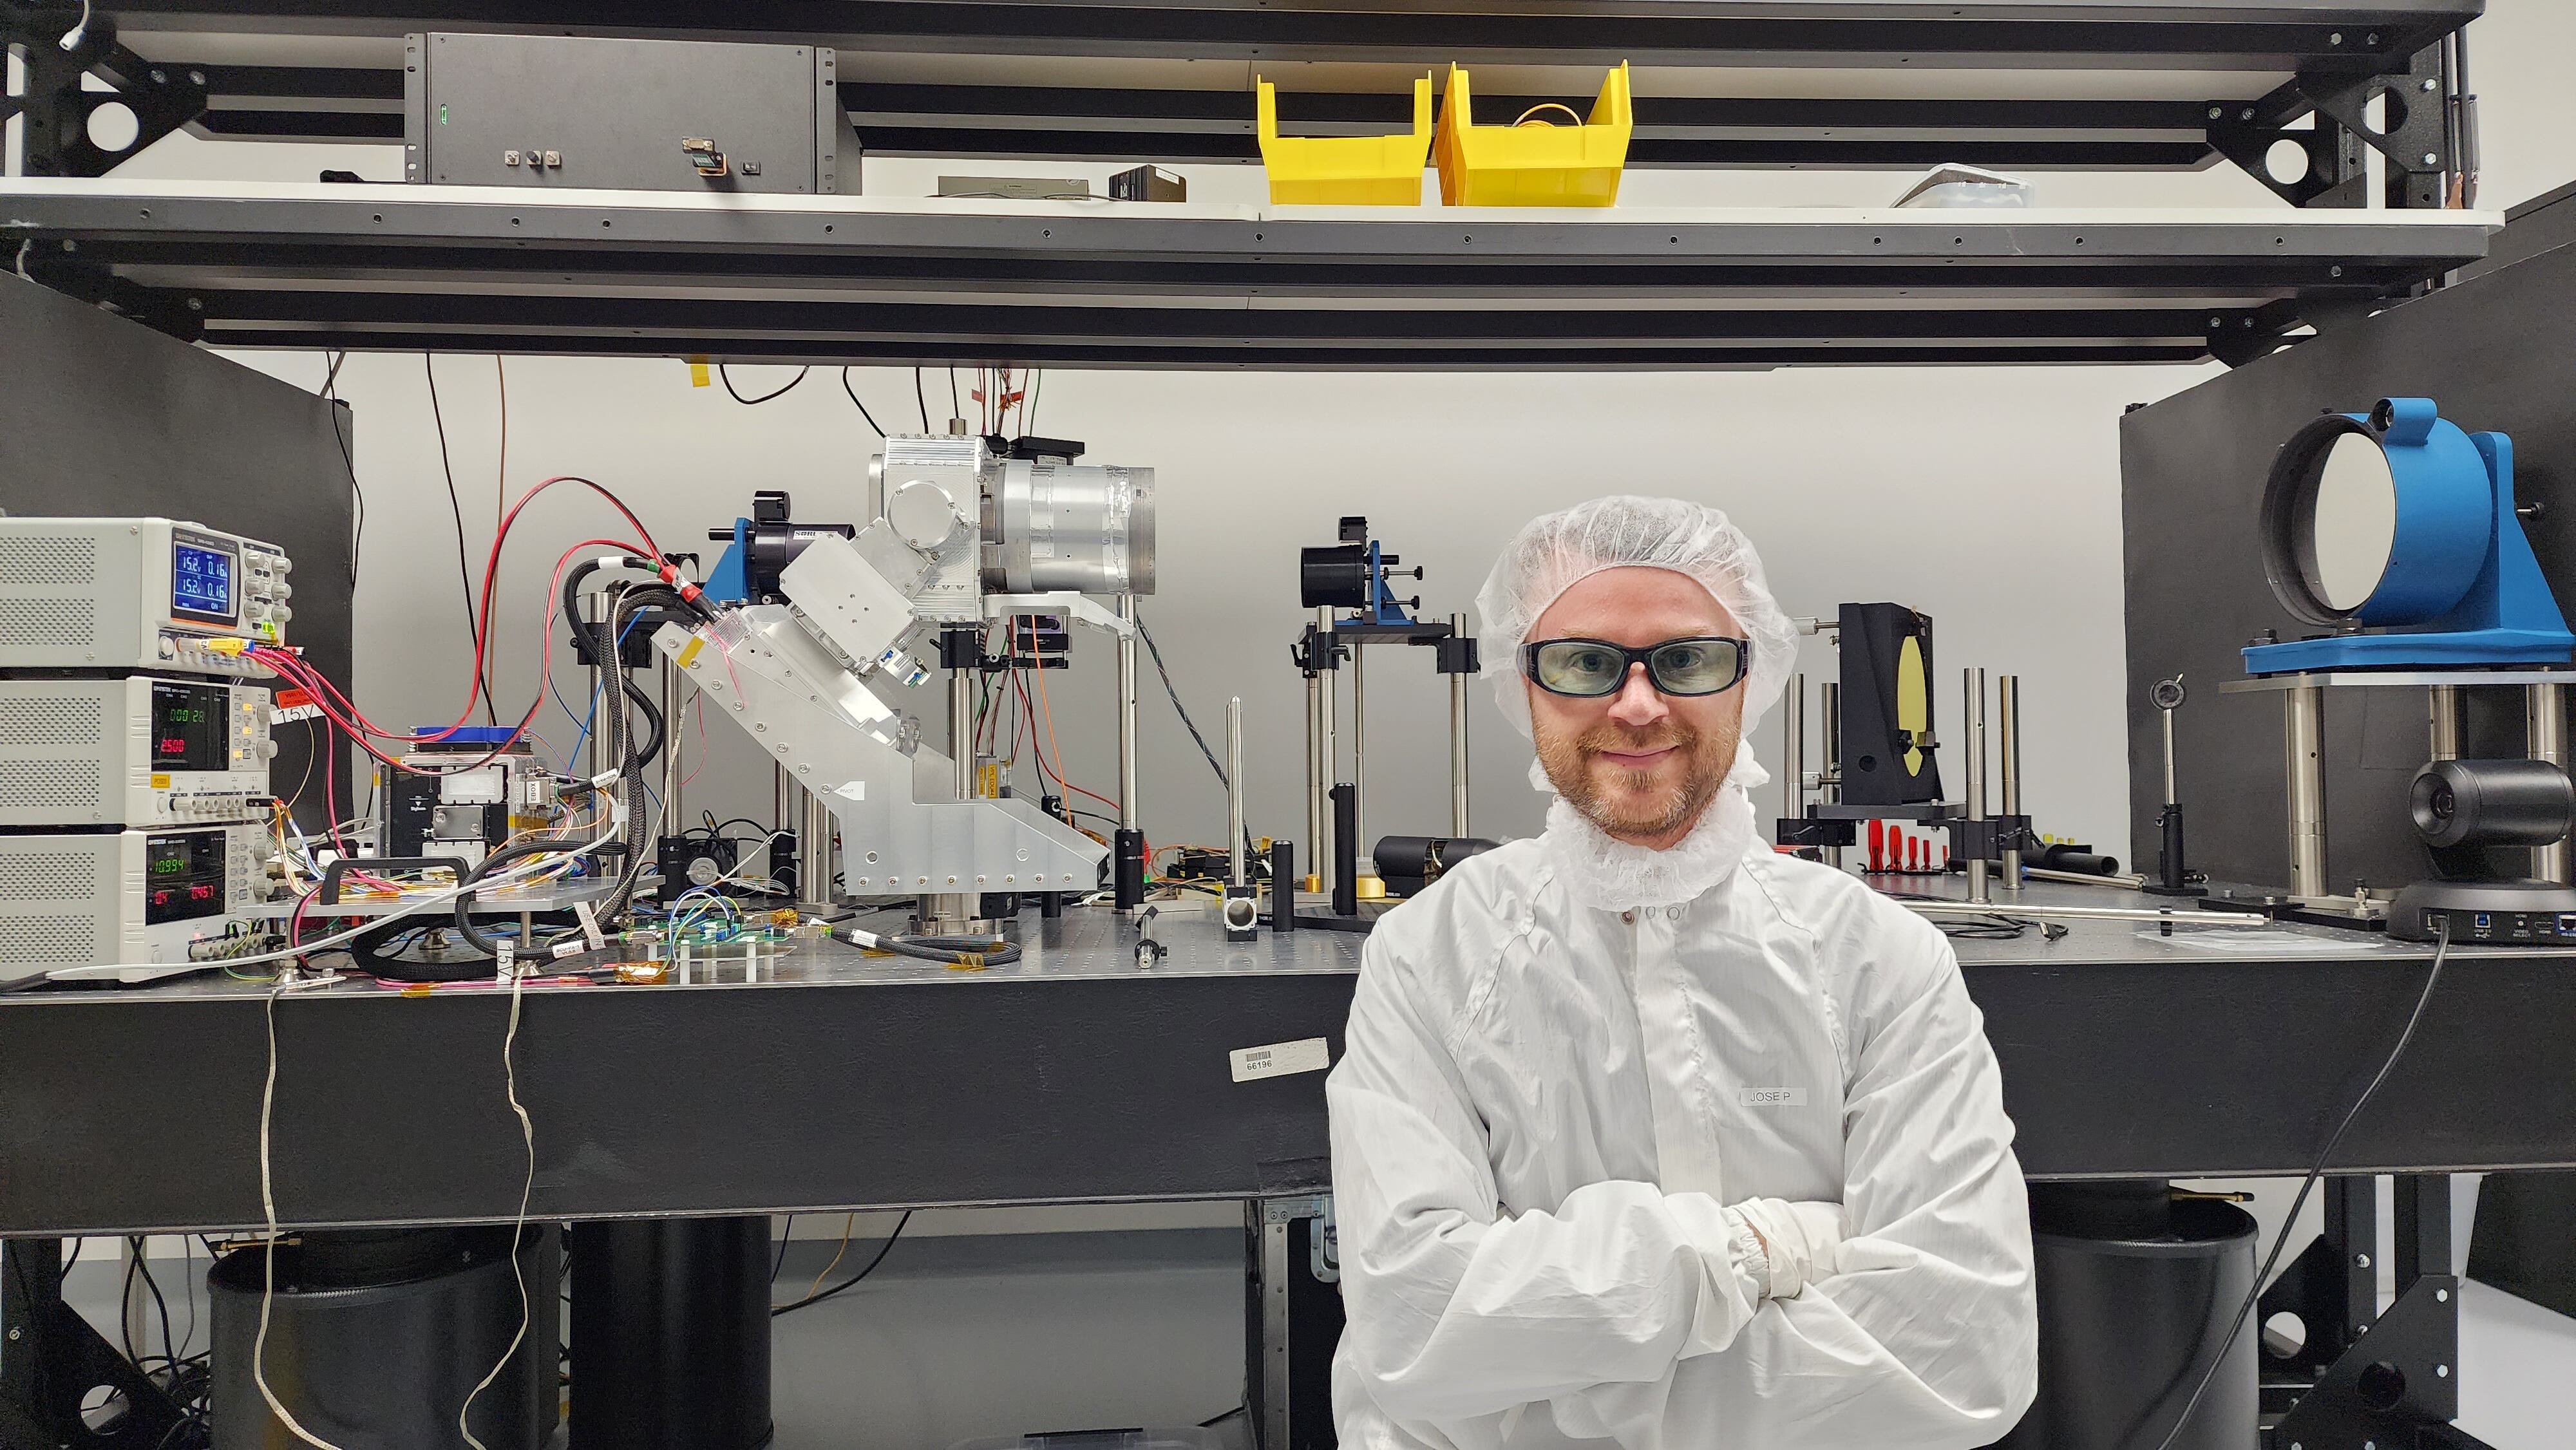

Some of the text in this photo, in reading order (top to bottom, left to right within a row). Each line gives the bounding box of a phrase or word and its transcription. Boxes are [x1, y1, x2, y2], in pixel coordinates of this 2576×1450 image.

[278, 704, 314, 722] 15V
[498, 946, 513, 977] 15V
[1247, 1060, 1272, 1070] 66196
[1750, 1091, 1790, 1102] JOSE P
